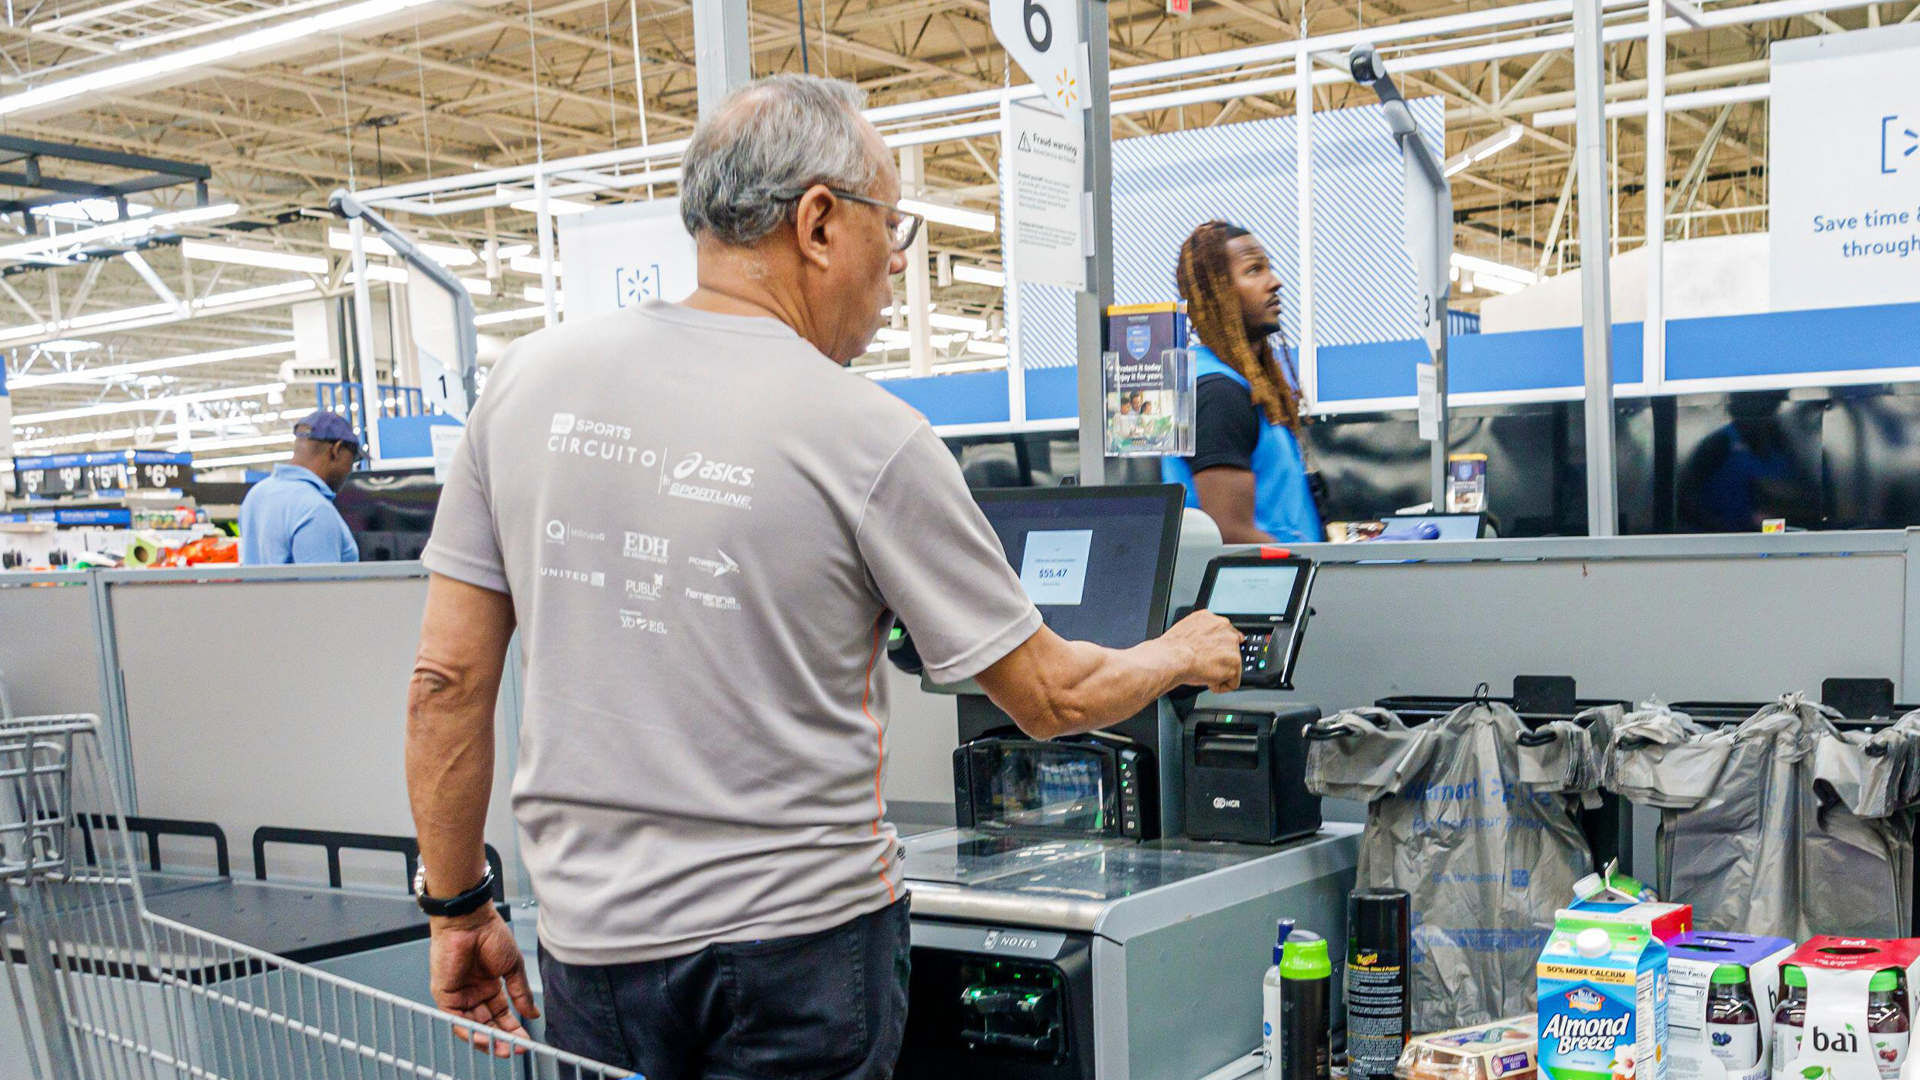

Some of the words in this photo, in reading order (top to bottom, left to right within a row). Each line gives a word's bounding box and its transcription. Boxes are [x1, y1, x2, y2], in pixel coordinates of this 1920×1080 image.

[1024, 0, 1053, 53] 6
[1033, 132, 1053, 147] Fraud
[1053, 141, 1078, 157] warning
[1813, 215, 1858, 233] Save
[1864, 210, 1909, 228] time
[437, 374, 448, 400] 1
[575, 418, 632, 441] SPORTS
[547, 435, 657, 468] CIRCUITO
[546, 520, 565, 540] Q
[624, 531, 670, 559] EDH
[540, 566, 589, 583] UNITED
[1039, 568, 1068, 578] $55.47
[1000, 936, 1037, 949] NOTES
[1547, 965, 1564, 974] 50%
[1565, 967, 1588, 976] MORE
[1590, 969, 1626, 979] CALCIUM
[1541, 1012, 1631, 1039] Almond
[1557, 1035, 1616, 1055] Breeze
[1812, 1024, 1858, 1053] bai
